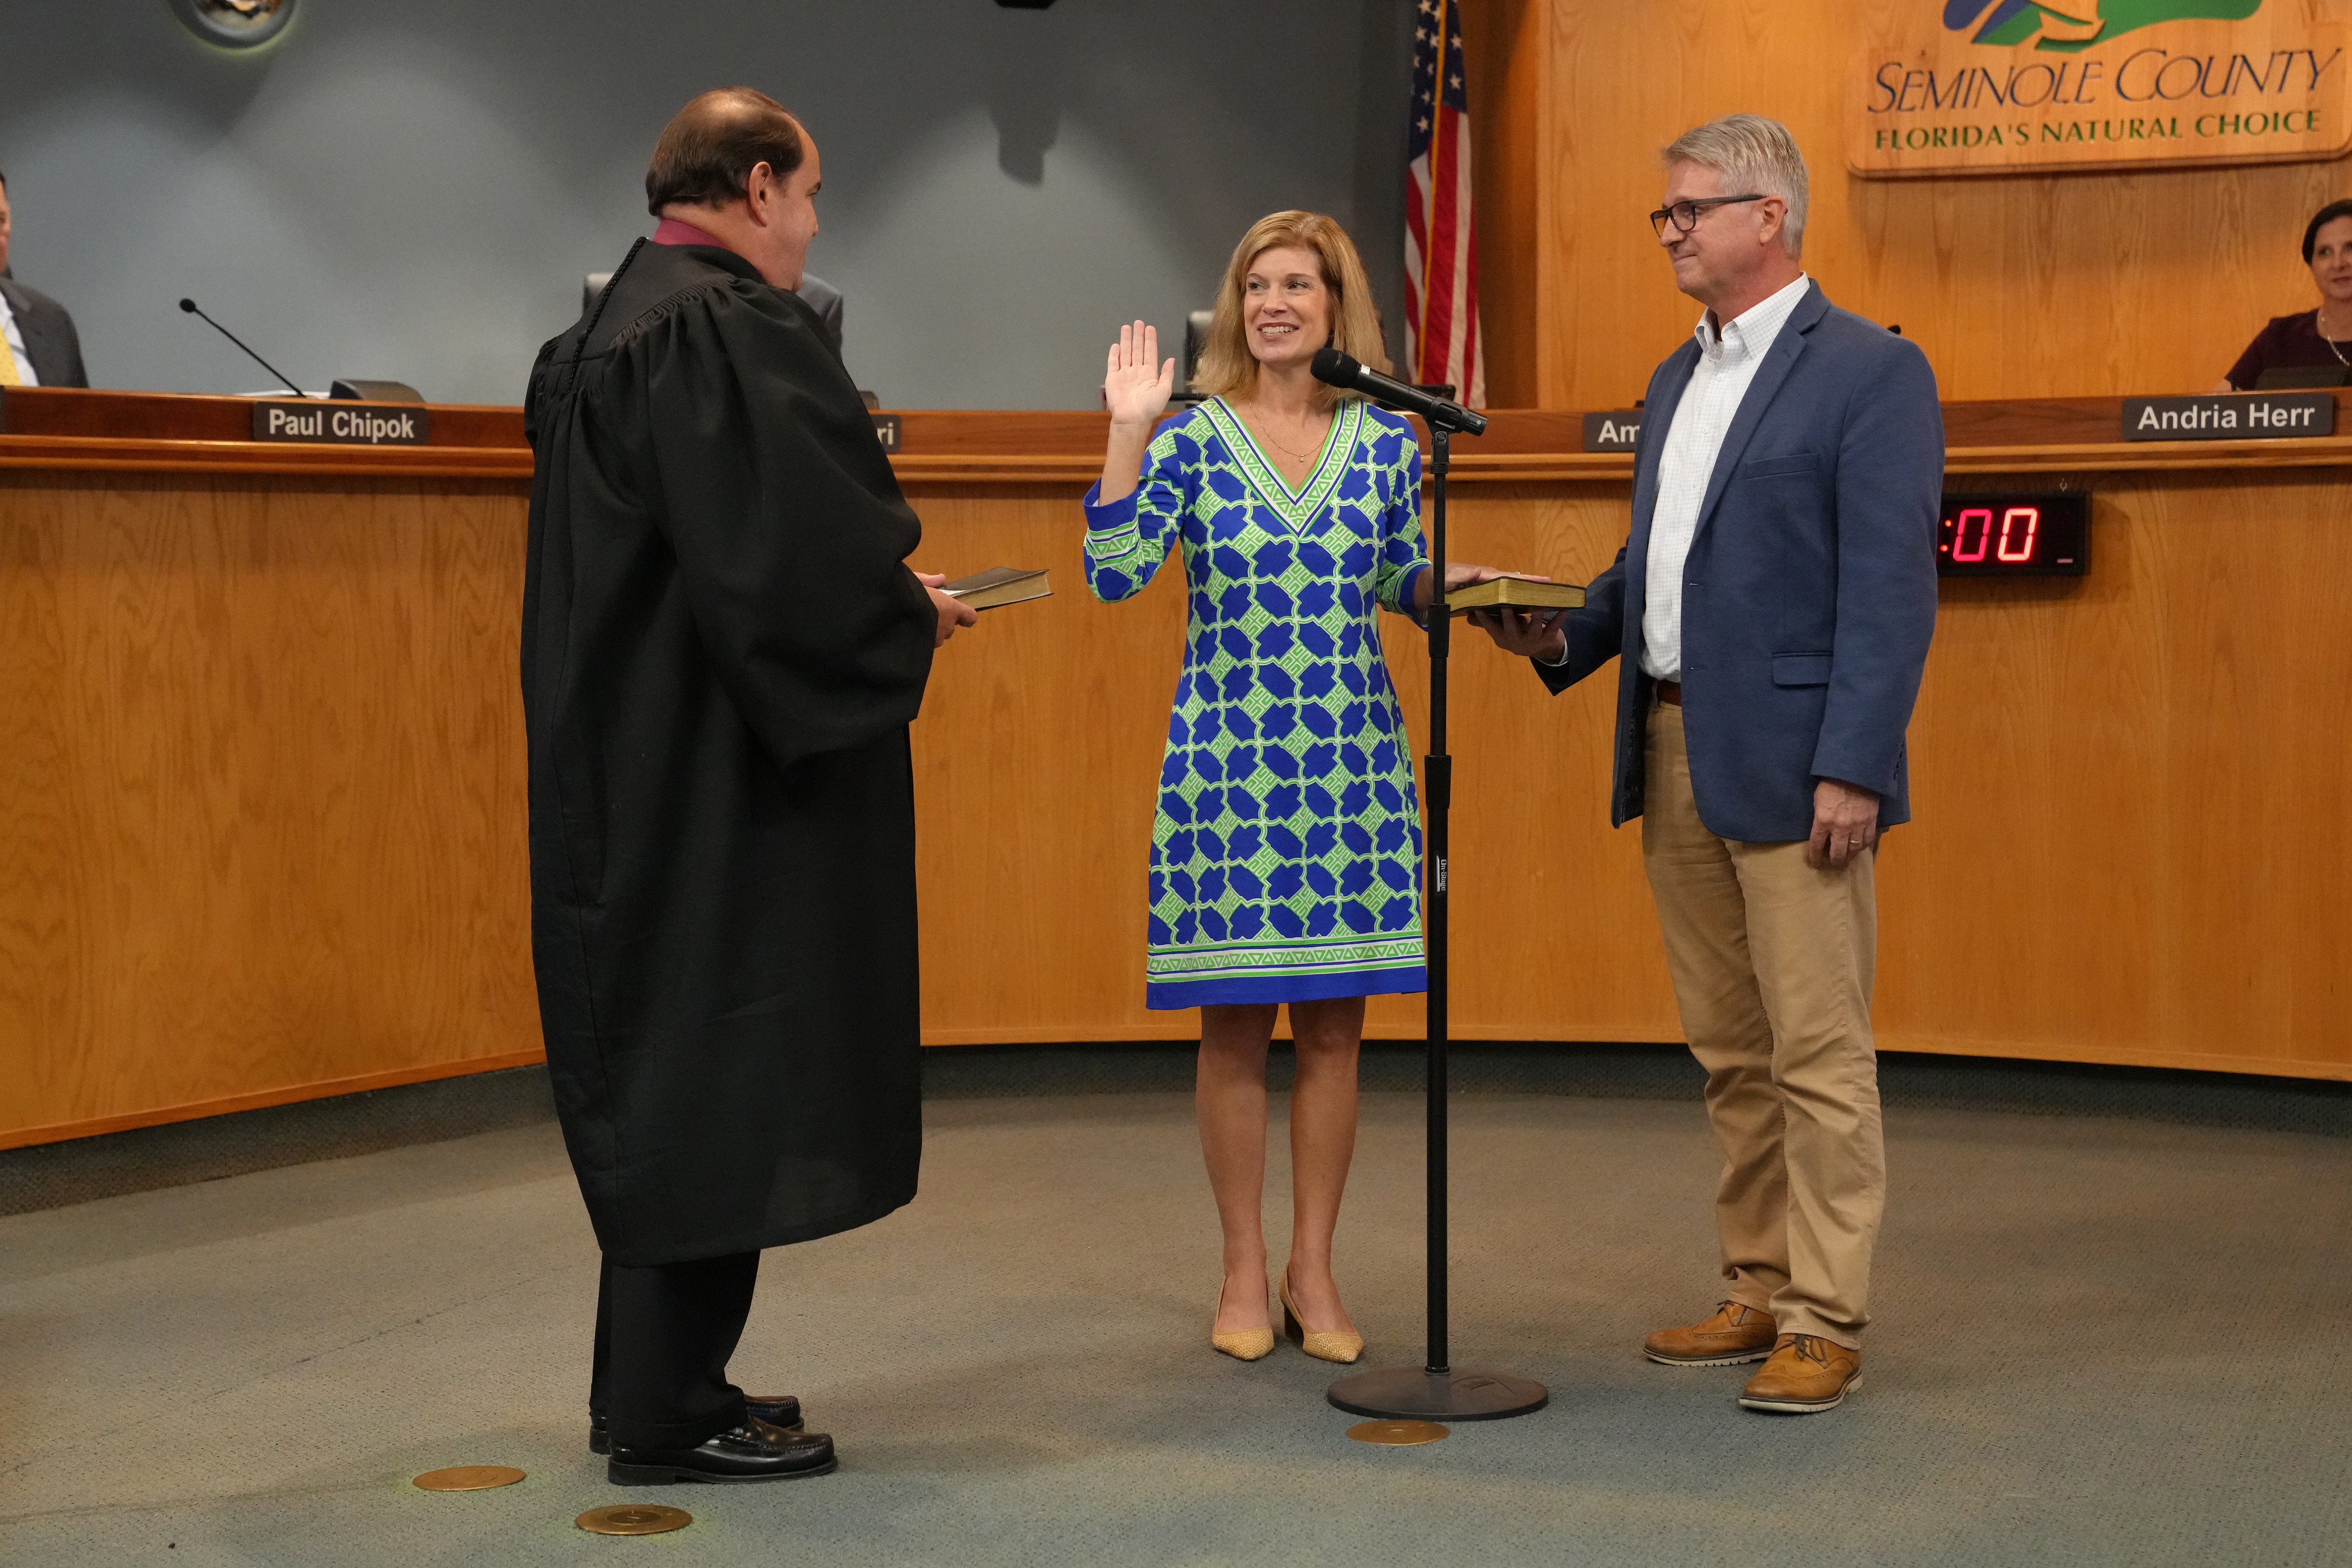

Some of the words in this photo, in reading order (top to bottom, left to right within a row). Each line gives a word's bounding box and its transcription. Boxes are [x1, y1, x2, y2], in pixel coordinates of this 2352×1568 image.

[1868, 61, 2103, 114] SEMINOLE
[2115, 48, 2342, 102] COUNTY
[1876, 121, 2030, 151] FLORIDA'S
[2041, 116, 2183, 144] NATURAL
[2195, 108, 2321, 138] CHOICE
[269, 408, 323, 436] Paul
[332, 411, 414, 444] Chipok
[2137, 404, 2237, 430] Andria
[2249, 403, 2315, 427] Herr
